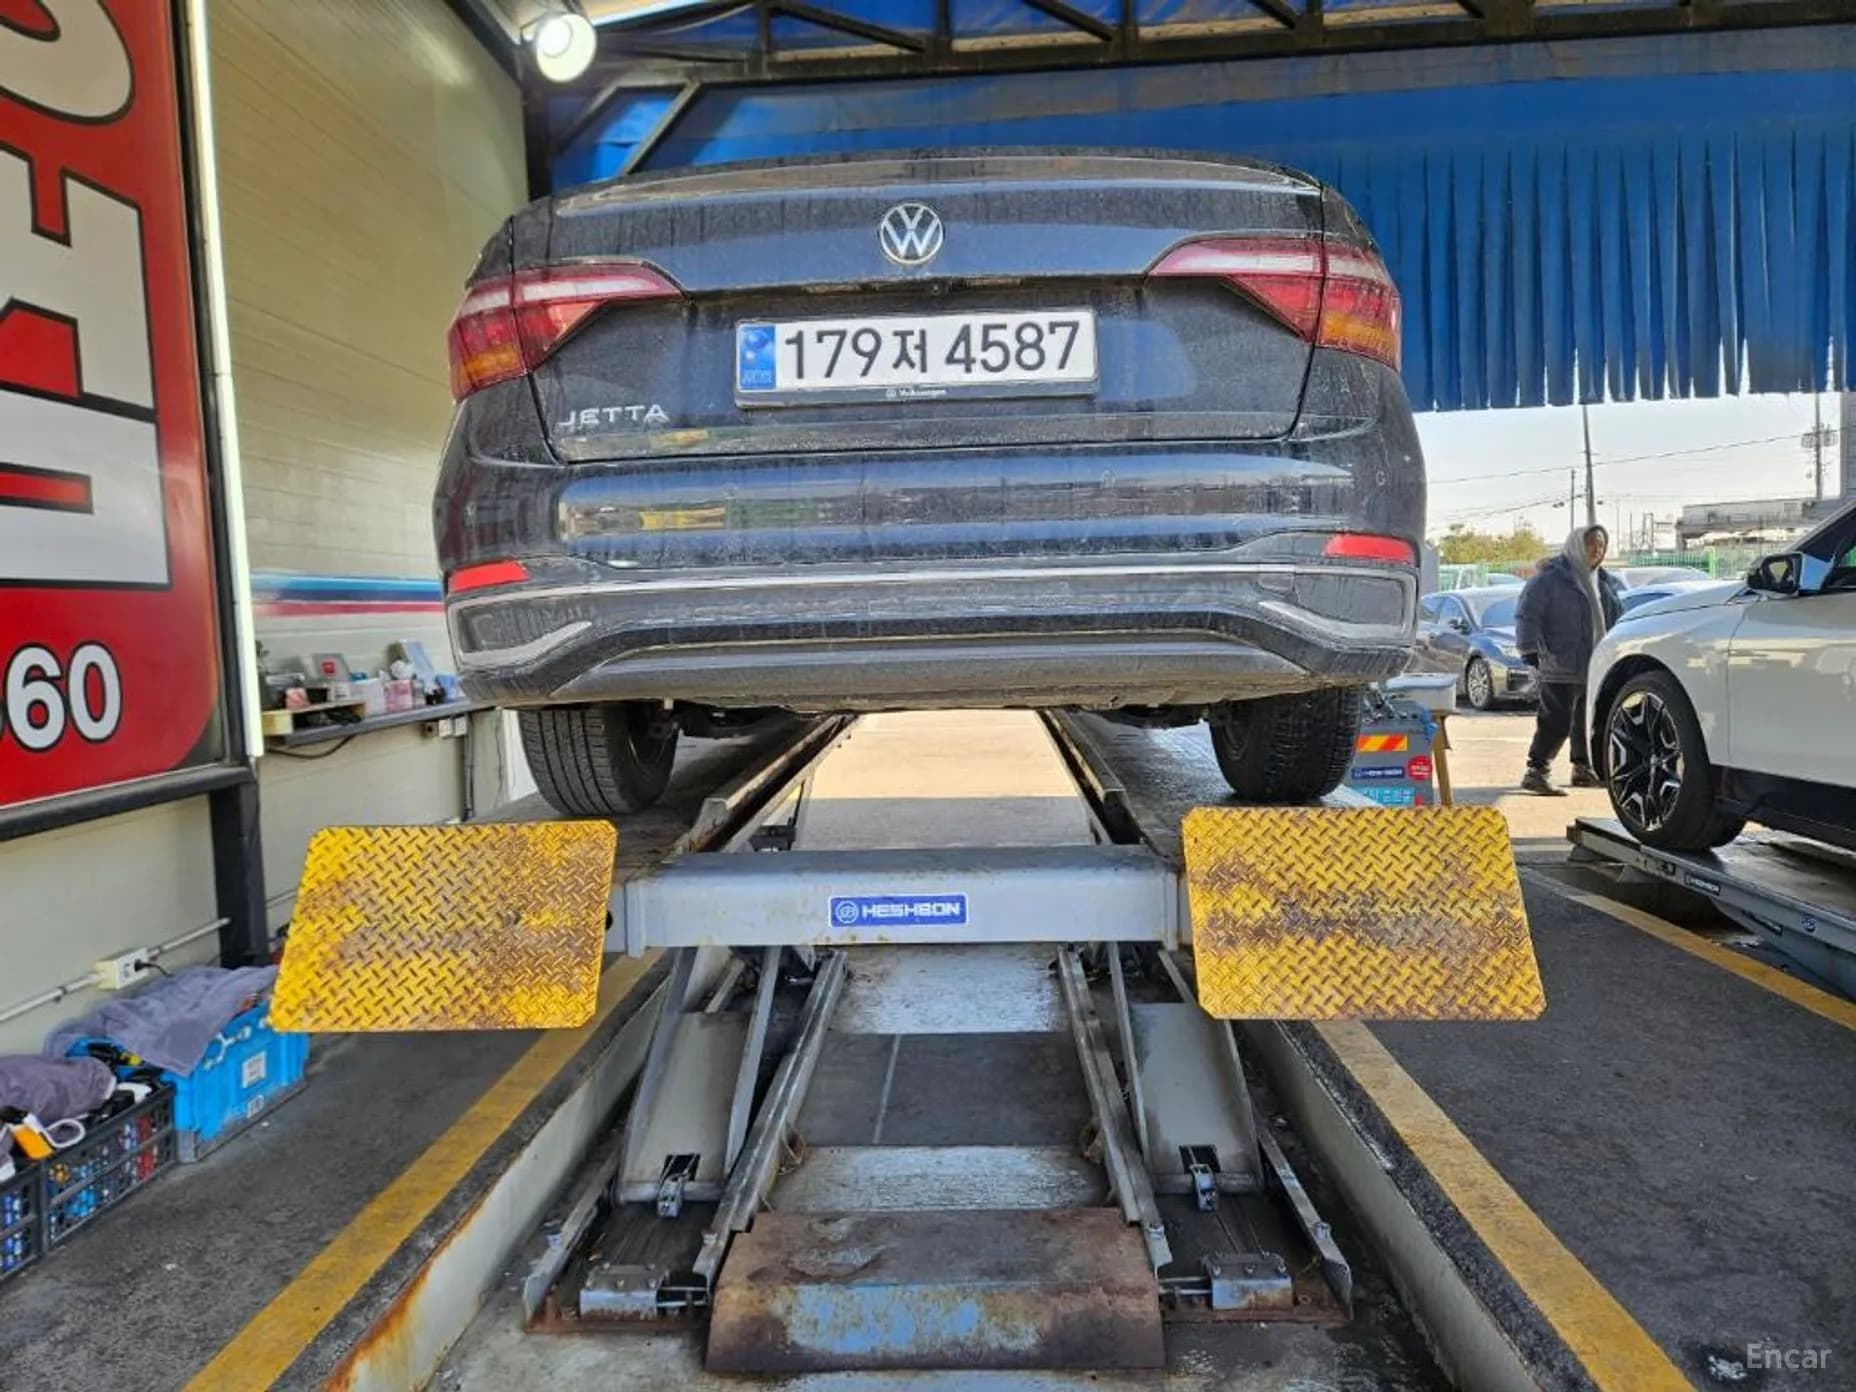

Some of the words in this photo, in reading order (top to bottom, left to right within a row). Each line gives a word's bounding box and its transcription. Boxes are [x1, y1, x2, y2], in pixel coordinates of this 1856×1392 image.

[945, 320, 1080, 374] 4587
[557, 403, 671, 427] JETTA
[0, 641, 122, 752] 60
[861, 902, 960, 919] HESHBON
